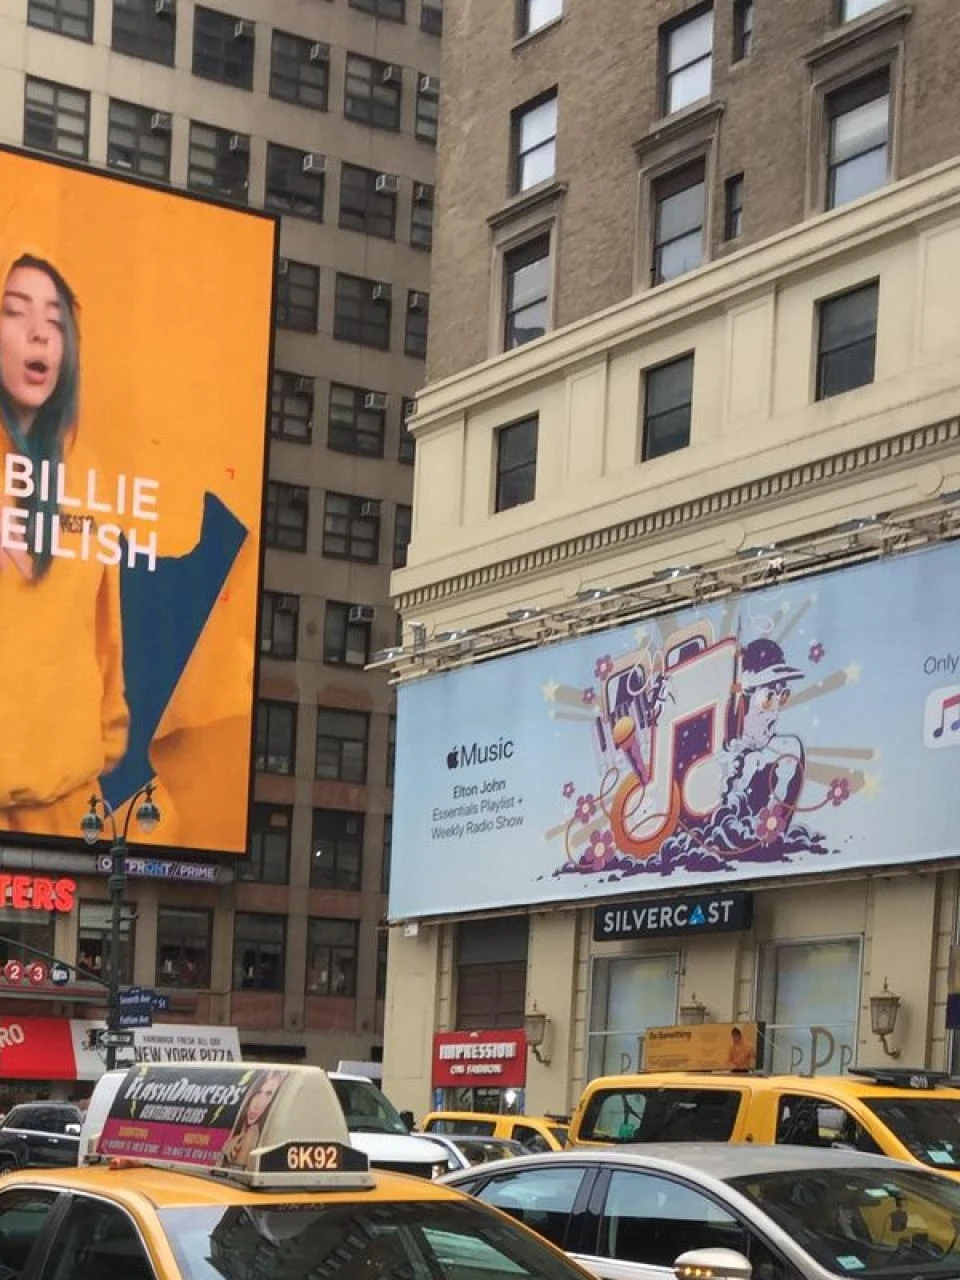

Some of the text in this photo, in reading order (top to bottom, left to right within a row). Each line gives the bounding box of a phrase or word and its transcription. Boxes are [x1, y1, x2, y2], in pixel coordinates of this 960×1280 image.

[4, 453, 160, 521] BILLIE
[0, 506, 158, 572] EILISH
[923, 653, 960, 675] Only
[460, 736, 514, 768] Music
[453, 780, 506, 799] Elton John
[432, 803, 479, 821] Essentials
[480, 797, 514, 814] Playlist
[432, 815, 524, 840] Weekly Radio Show
[602, 900, 734, 933] SILVERCAST
[10, 967, 21, 979] 2
[33, 967, 44, 981] 3
[134, 1047, 162, 1063] NEW
[164, 1048, 196, 1063] YORK
[439, 1042, 517, 1060] IMPRESSION
[287, 1146, 338, 1170] 6K92
